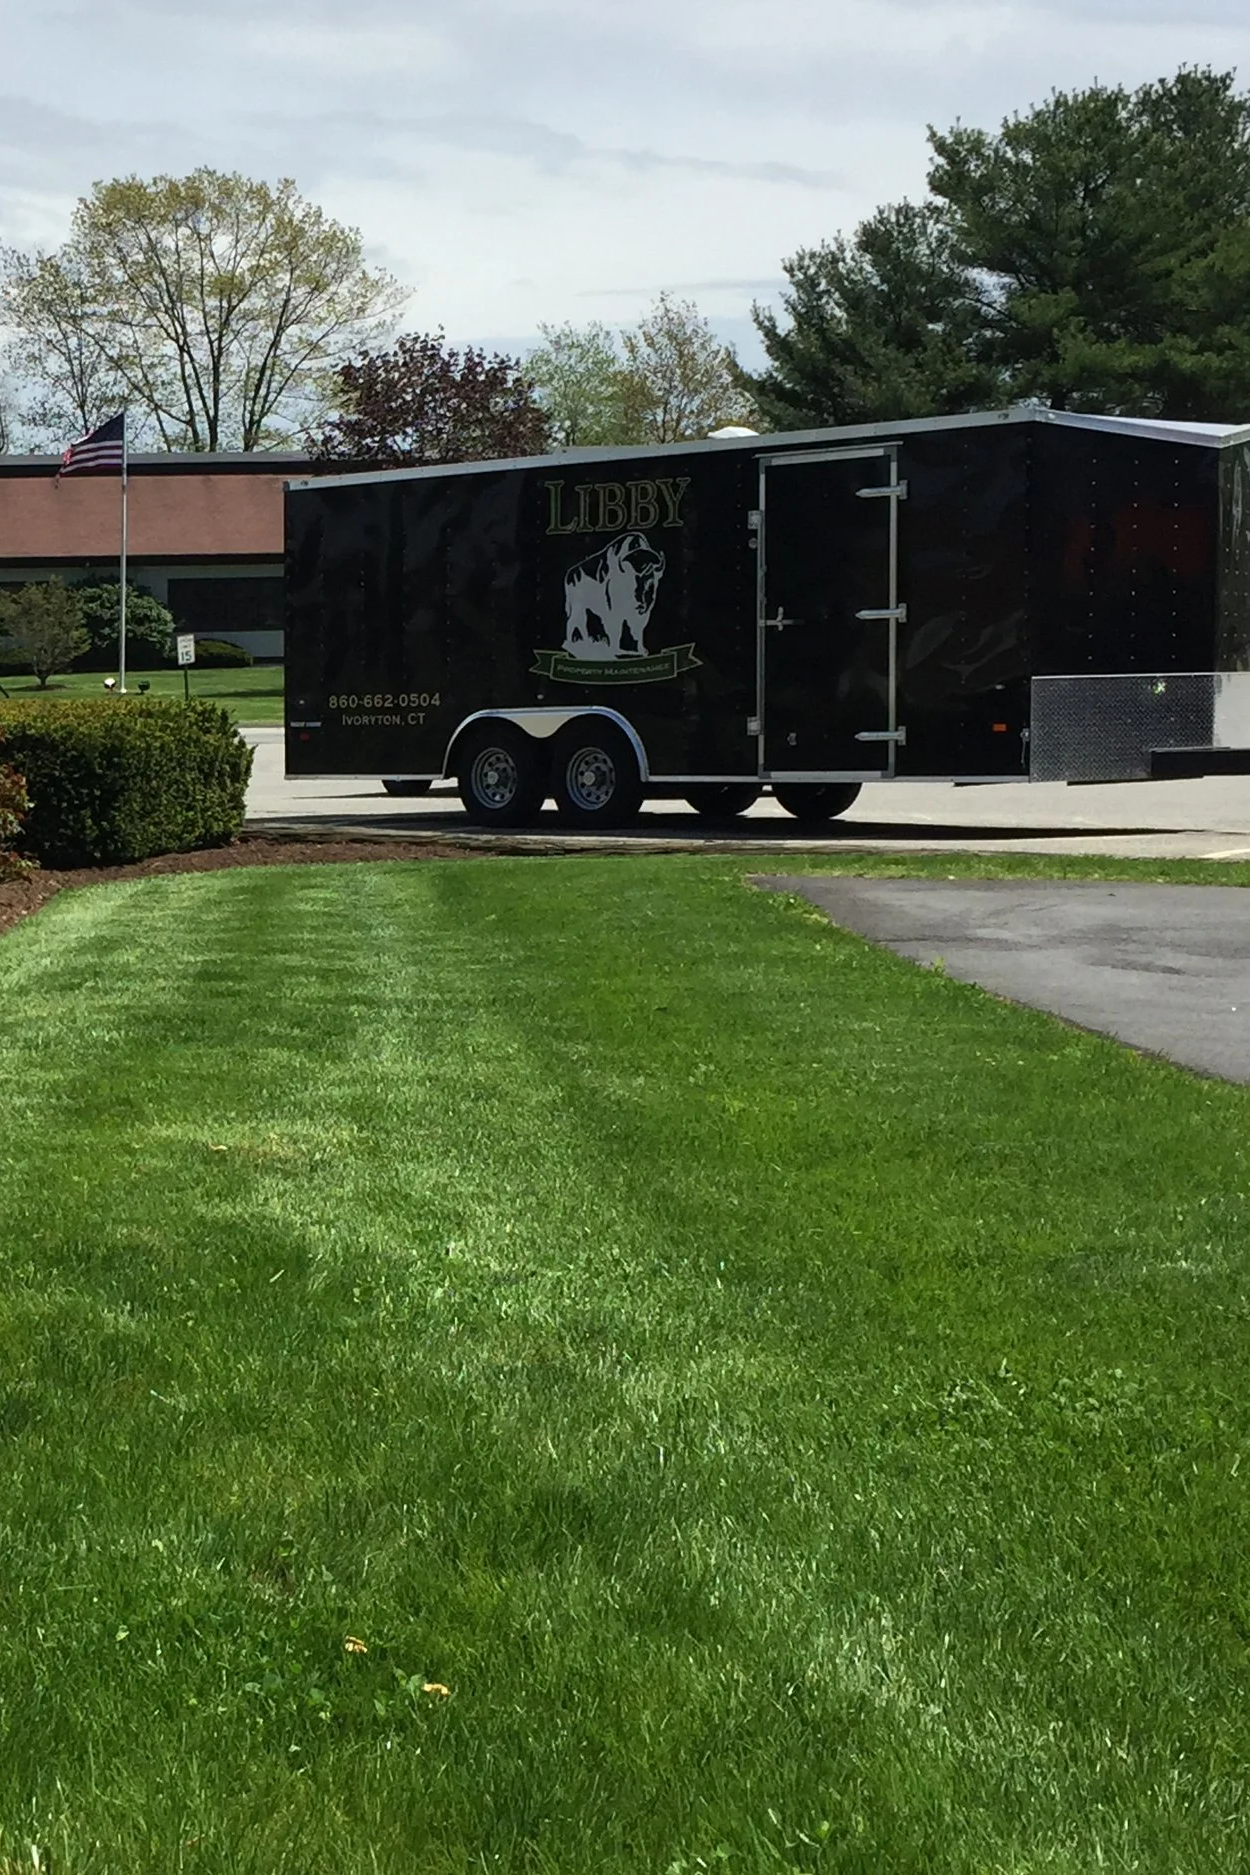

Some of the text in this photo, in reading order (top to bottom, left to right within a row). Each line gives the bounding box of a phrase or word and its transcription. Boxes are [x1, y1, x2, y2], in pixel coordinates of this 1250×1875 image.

[544, 477, 691, 534] LIBBY
[181, 650, 192, 661] 15
[328, 692, 441, 708] 860-662-0504
[342, 713, 426, 726] IVORYTON, CT
